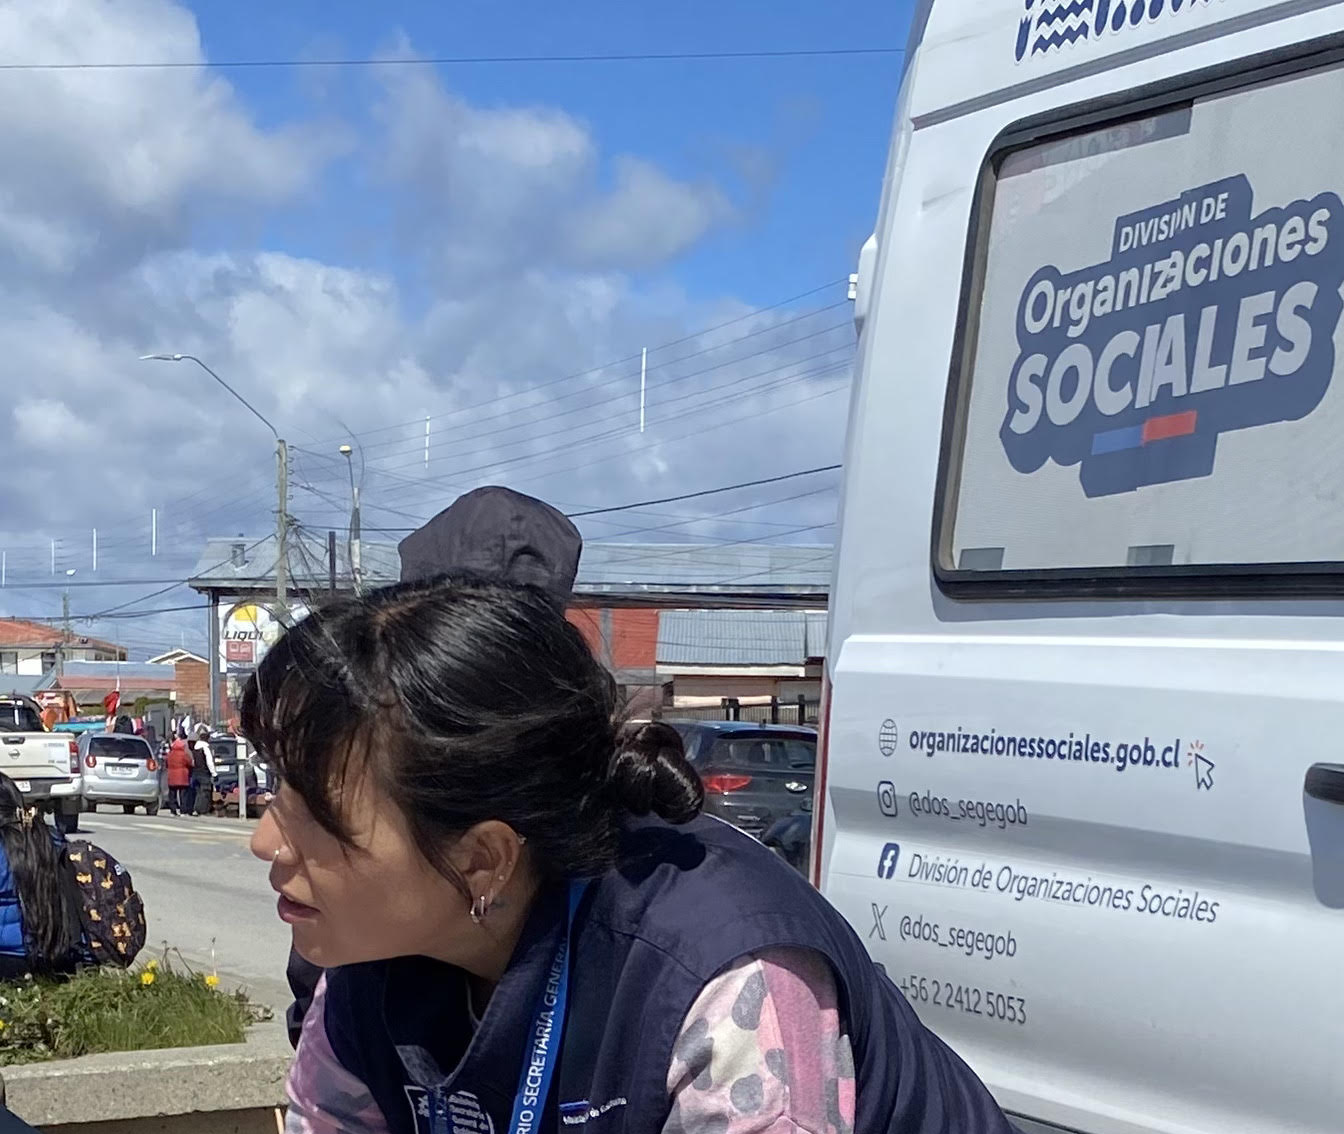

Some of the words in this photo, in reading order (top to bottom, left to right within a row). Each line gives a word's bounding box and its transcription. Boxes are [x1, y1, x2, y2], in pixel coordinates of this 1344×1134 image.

[1119, 202, 1197, 253] DIVISIN
[1200, 192, 1229, 224] DE
[1025, 208, 1330, 338] Organizaciones
[1009, 281, 1318, 434] SOCIALES
[909, 726, 1181, 771] organizacionessociales.gob.cl
[909, 789, 1028, 829] @dos_segegob
[908, 853, 967, 887] División
[971, 863, 993, 890] de
[996, 866, 1134, 911] Organizaciones
[1136, 884, 1221, 924] Sociales
[899, 914, 1017, 960] @dos_segegob
[900, 975, 929, 1002] +56
[932, 980, 942, 1006] 2
[945, 982, 983, 1015] 2412
[986, 991, 1027, 1025] 5053
[524, 1010, 555, 1108] SECRETARÍA
